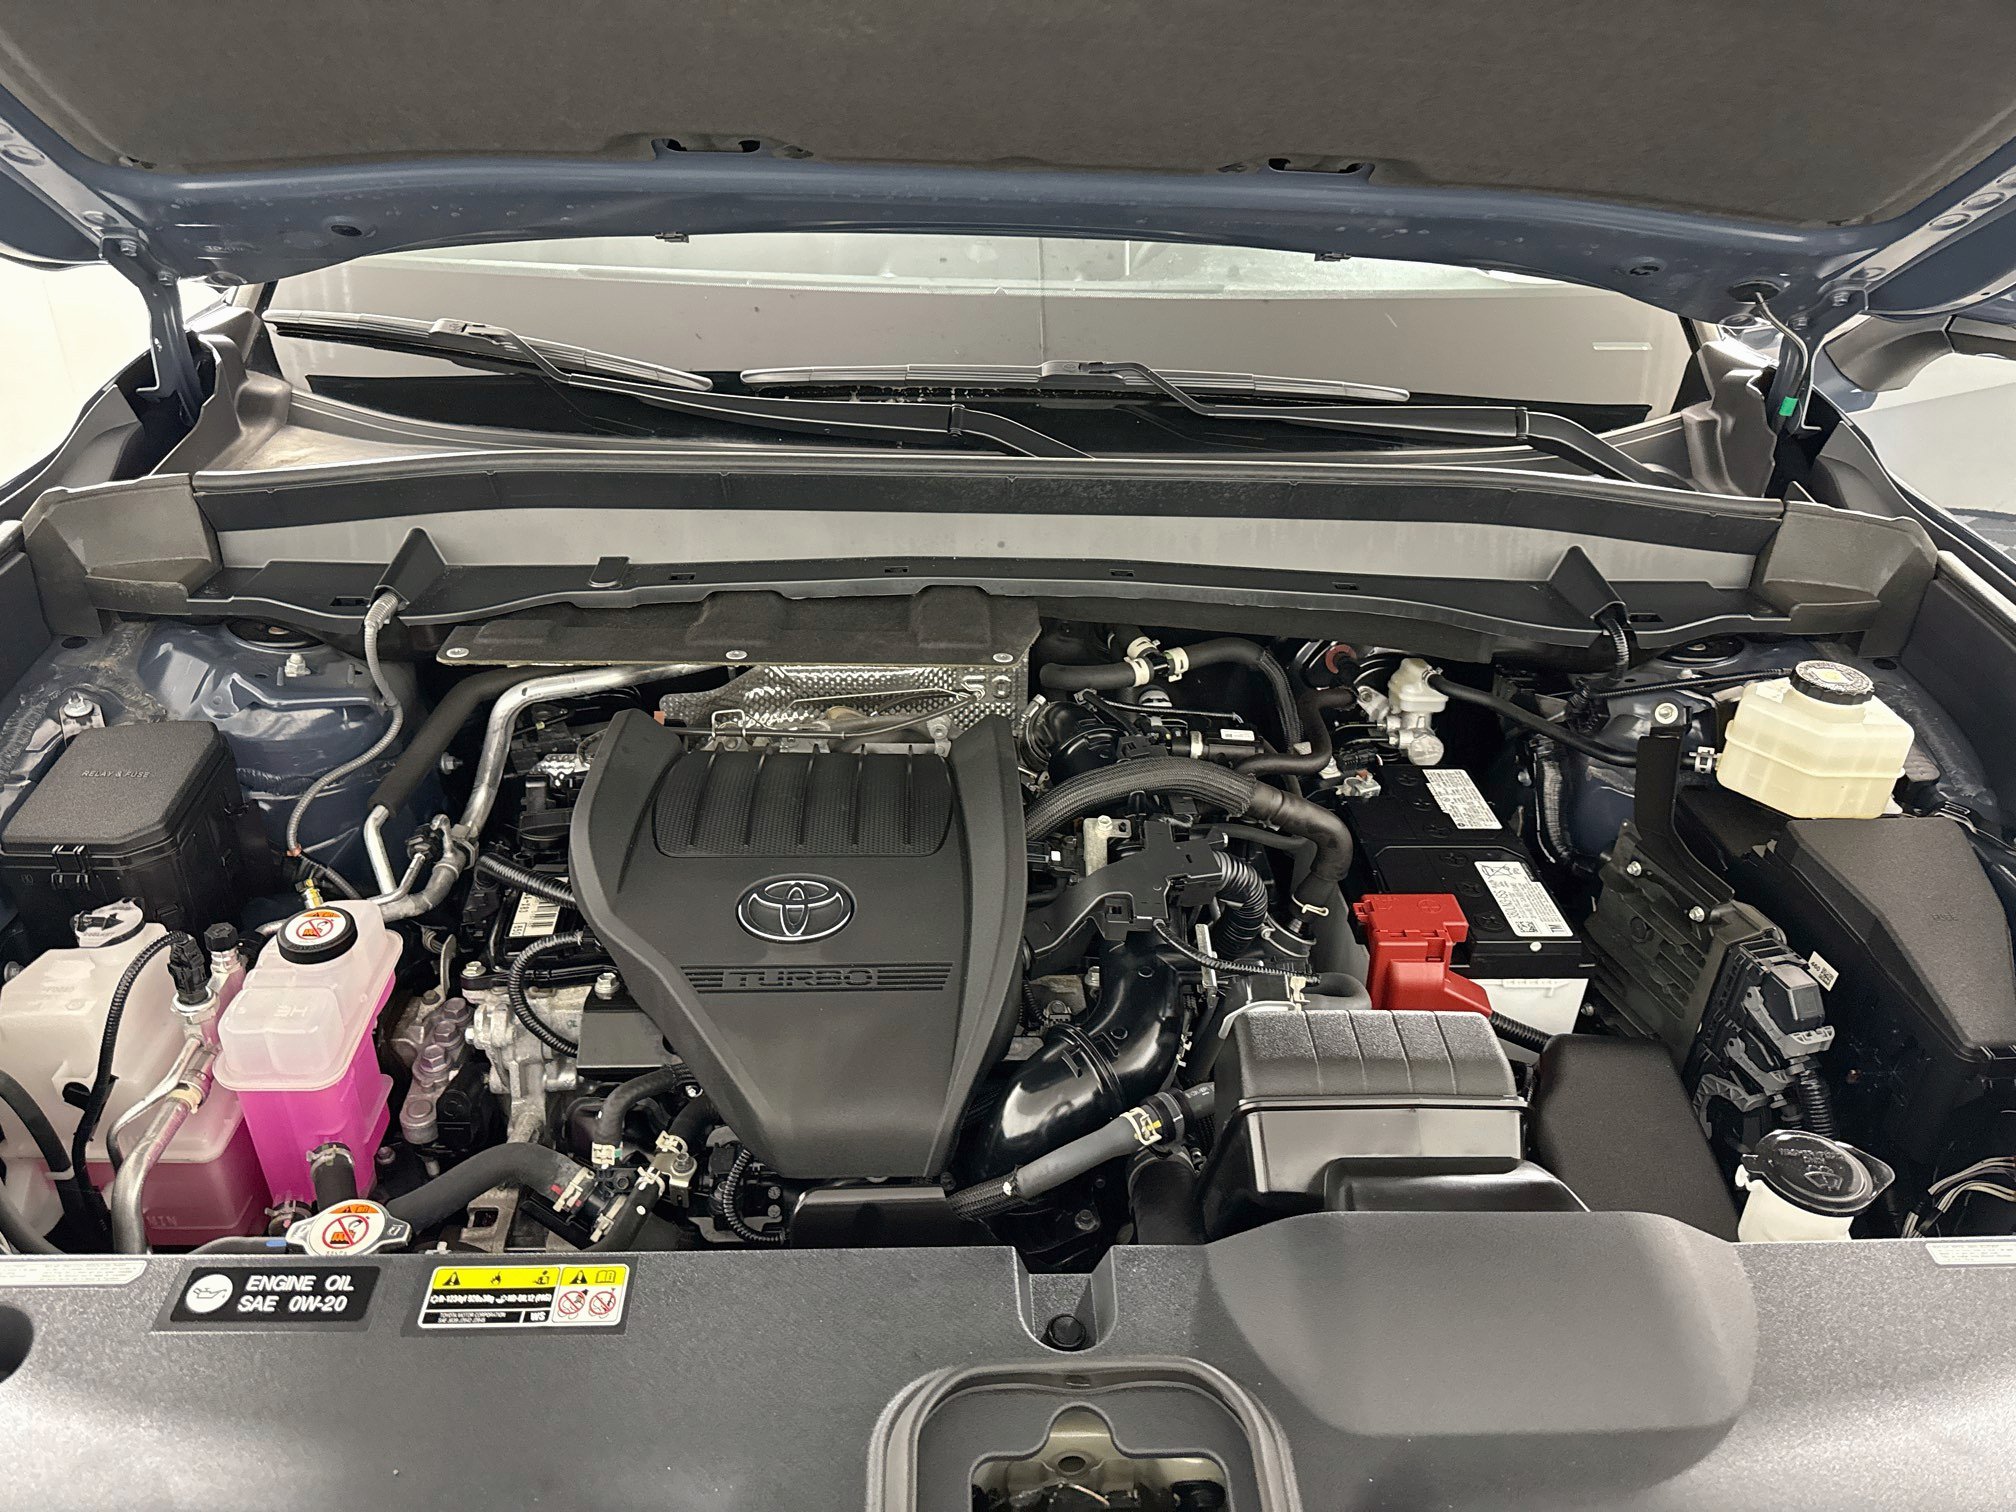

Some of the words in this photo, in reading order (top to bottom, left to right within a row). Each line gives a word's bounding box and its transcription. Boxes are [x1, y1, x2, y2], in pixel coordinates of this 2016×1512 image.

[729, 968, 873, 987] TURBO
[245, 1274, 317, 1291] ENGINE
[324, 1274, 355, 1291] OIL
[237, 1295, 280, 1312] SAE
[288, 1295, 349, 1312] 0W-20
[530, 1311, 547, 1321] WS
